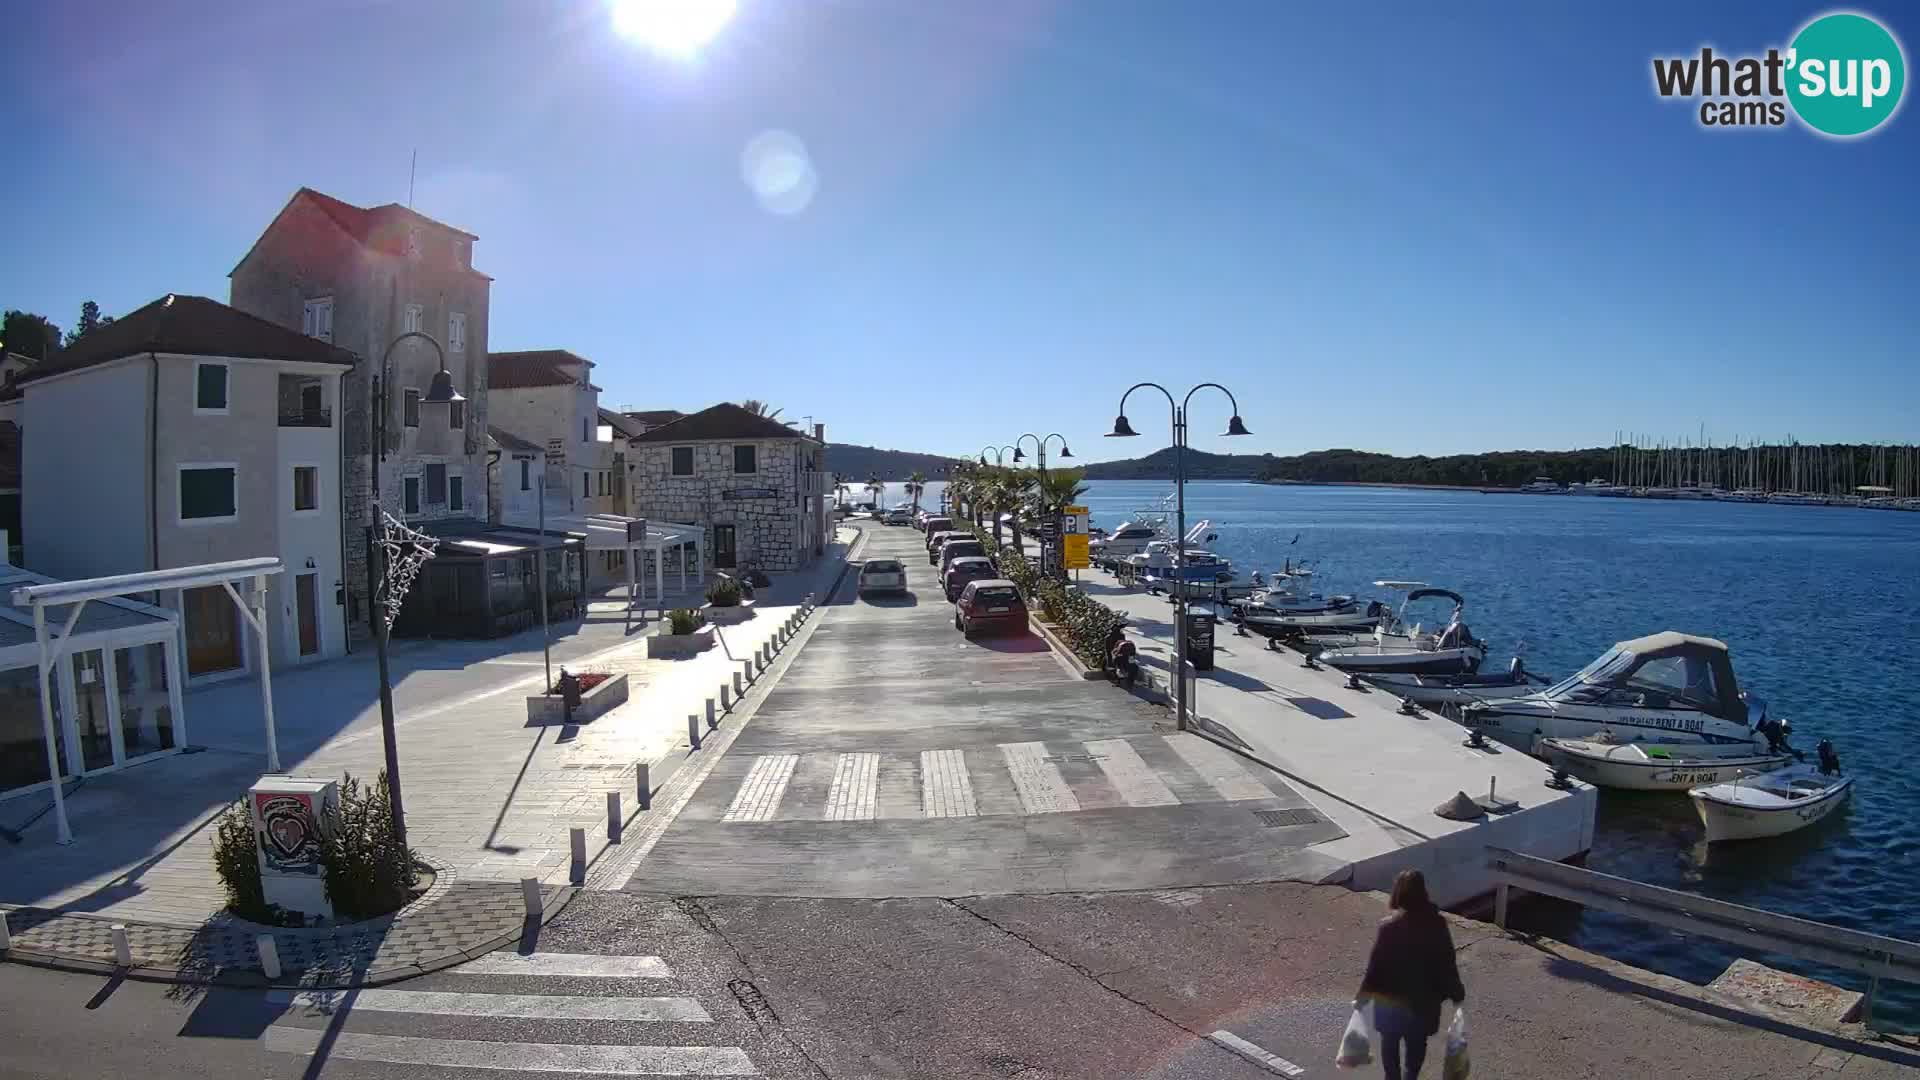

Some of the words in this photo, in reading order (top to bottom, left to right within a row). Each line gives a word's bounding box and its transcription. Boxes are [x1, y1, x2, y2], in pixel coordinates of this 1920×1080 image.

[1065, 516, 1076, 531] P
[1656, 718, 1677, 730] RENT
[1685, 720, 1705, 731] BOAT
[1697, 773, 1719, 784] BOAT
